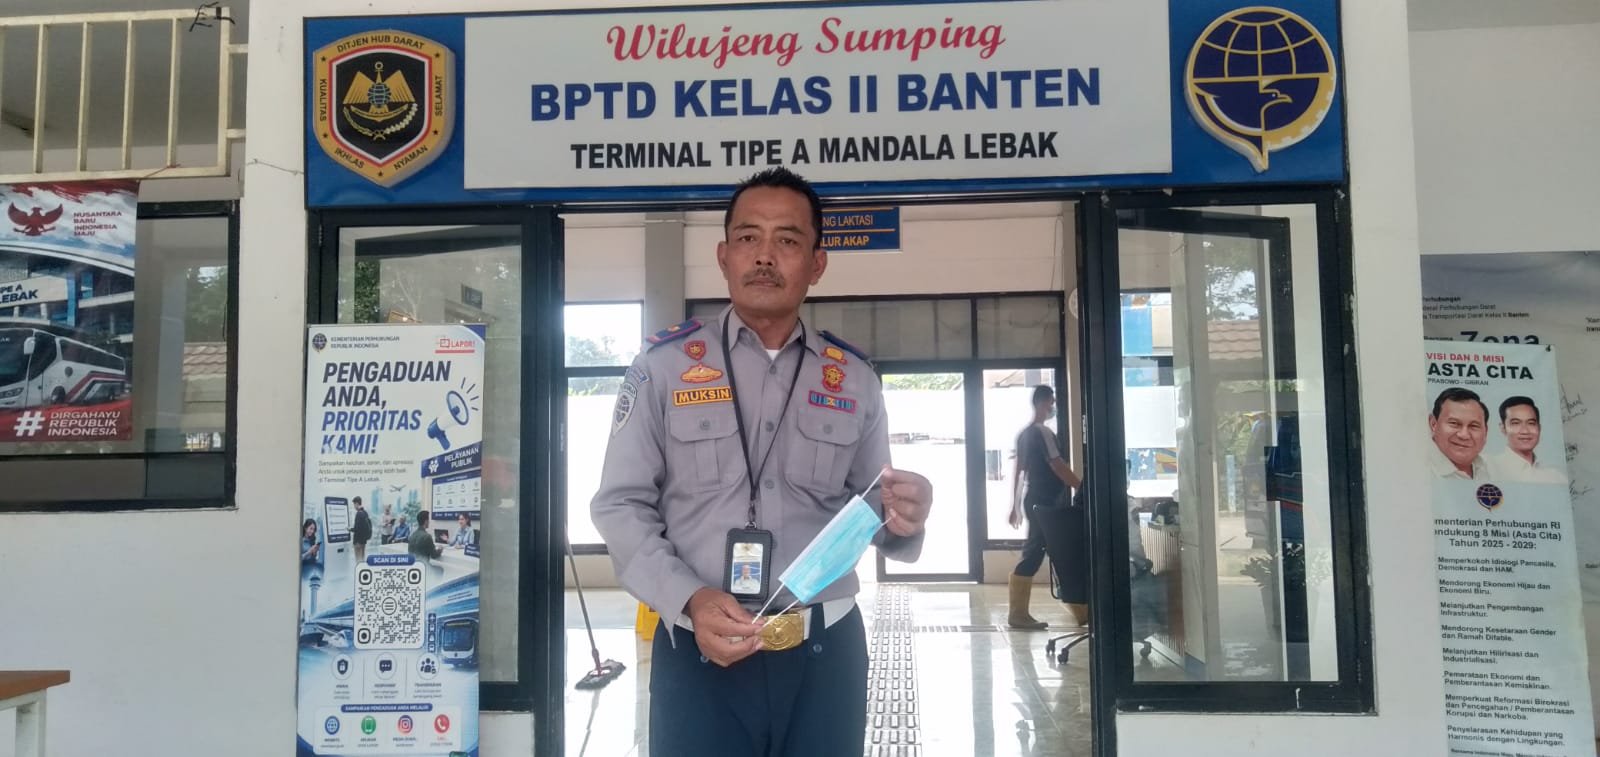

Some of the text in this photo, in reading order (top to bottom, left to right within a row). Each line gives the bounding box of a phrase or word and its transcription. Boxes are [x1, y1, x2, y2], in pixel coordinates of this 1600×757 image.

[337, 35, 425, 53] DITJEN HUB DARAT
[607, 17, 1006, 69] Wilujeng Sumping
[319, 78, 327, 122] KUALITAS
[434, 75, 443, 117] SELAMAT
[531, 67, 1100, 121] BPTD KELAS II BANTEN
[570, 131, 1059, 169] TERMINAL TIPE A MANDALA LEBAK
[334, 147, 365, 169] IKHLAS
[393, 145, 428, 170] NYAMAN
[822, 214, 874, 227] NG LAKTASI
[820, 235, 870, 248] LUR AKAP
[0, 289, 38, 304] EBAK
[1426, 352, 1447, 360] VISI
[1450, 353, 1471, 361] DAN
[1482, 355, 1505, 363] MISI
[323, 361, 451, 383] PENGADUAN
[1428, 363, 1534, 380] ASTA CITA
[322, 385, 387, 410] ANDA,
[678, 388, 731, 403] MUKSIN
[51, 411, 120, 419] DIRGAHAYU
[321, 409, 422, 431] PRIORITAS
[13, 411, 45, 436] #
[48, 428, 117, 436] INDONESIA
[321, 434, 379, 454] KAMI!
[444, 447, 479, 463] PELAYANAN
[451, 457, 474, 469] PUBLIK
[1434, 518, 1483, 526] menterian
[1485, 519, 1548, 530] Perhubungan
[1482, 529, 1488, 537] 8
[1491, 529, 1510, 538] Misi
[1513, 530, 1537, 540] (Asta
[1539, 531, 1562, 541] Cita)
[1449, 539, 1479, 547] Tahun
[1482, 540, 1504, 548] 2025
[1512, 541, 1537, 549] 2029:
[1438, 557, 1490, 566] Memperkokoh
[1491, 559, 1519, 567] Idiologi
[1439, 579, 1481, 588] Mendorong
[1517, 582, 1536, 590] Hijau
[1440, 602, 1544, 613] Melanjutkan Pengembangan
[1441, 625, 1556, 636] Mendorong Kesetaraan Gender
[1443, 648, 1488, 656] Melanjutkan
[1489, 649, 1523, 658] Hilirisasi
[1490, 673, 1524, 681] Ekonomi
[1526, 674, 1541, 682] dan
[1445, 679, 1552, 690] Pemberantasan Kemiskinan.
[1445, 694, 1570, 707] Memperkuat Reformasi Birokrasi
[1446, 710, 1476, 718] Korupsi
[1494, 712, 1529, 720] Narkoba.
[1462, 703, 1509, 713] Pencegahan
[1515, 705, 1575, 715] Pemberantasan
[1447, 725, 1564, 739] Penyelarasan Kehidupan yang
[1448, 733, 1566, 746] Harmonis dengan Lingkungan.
